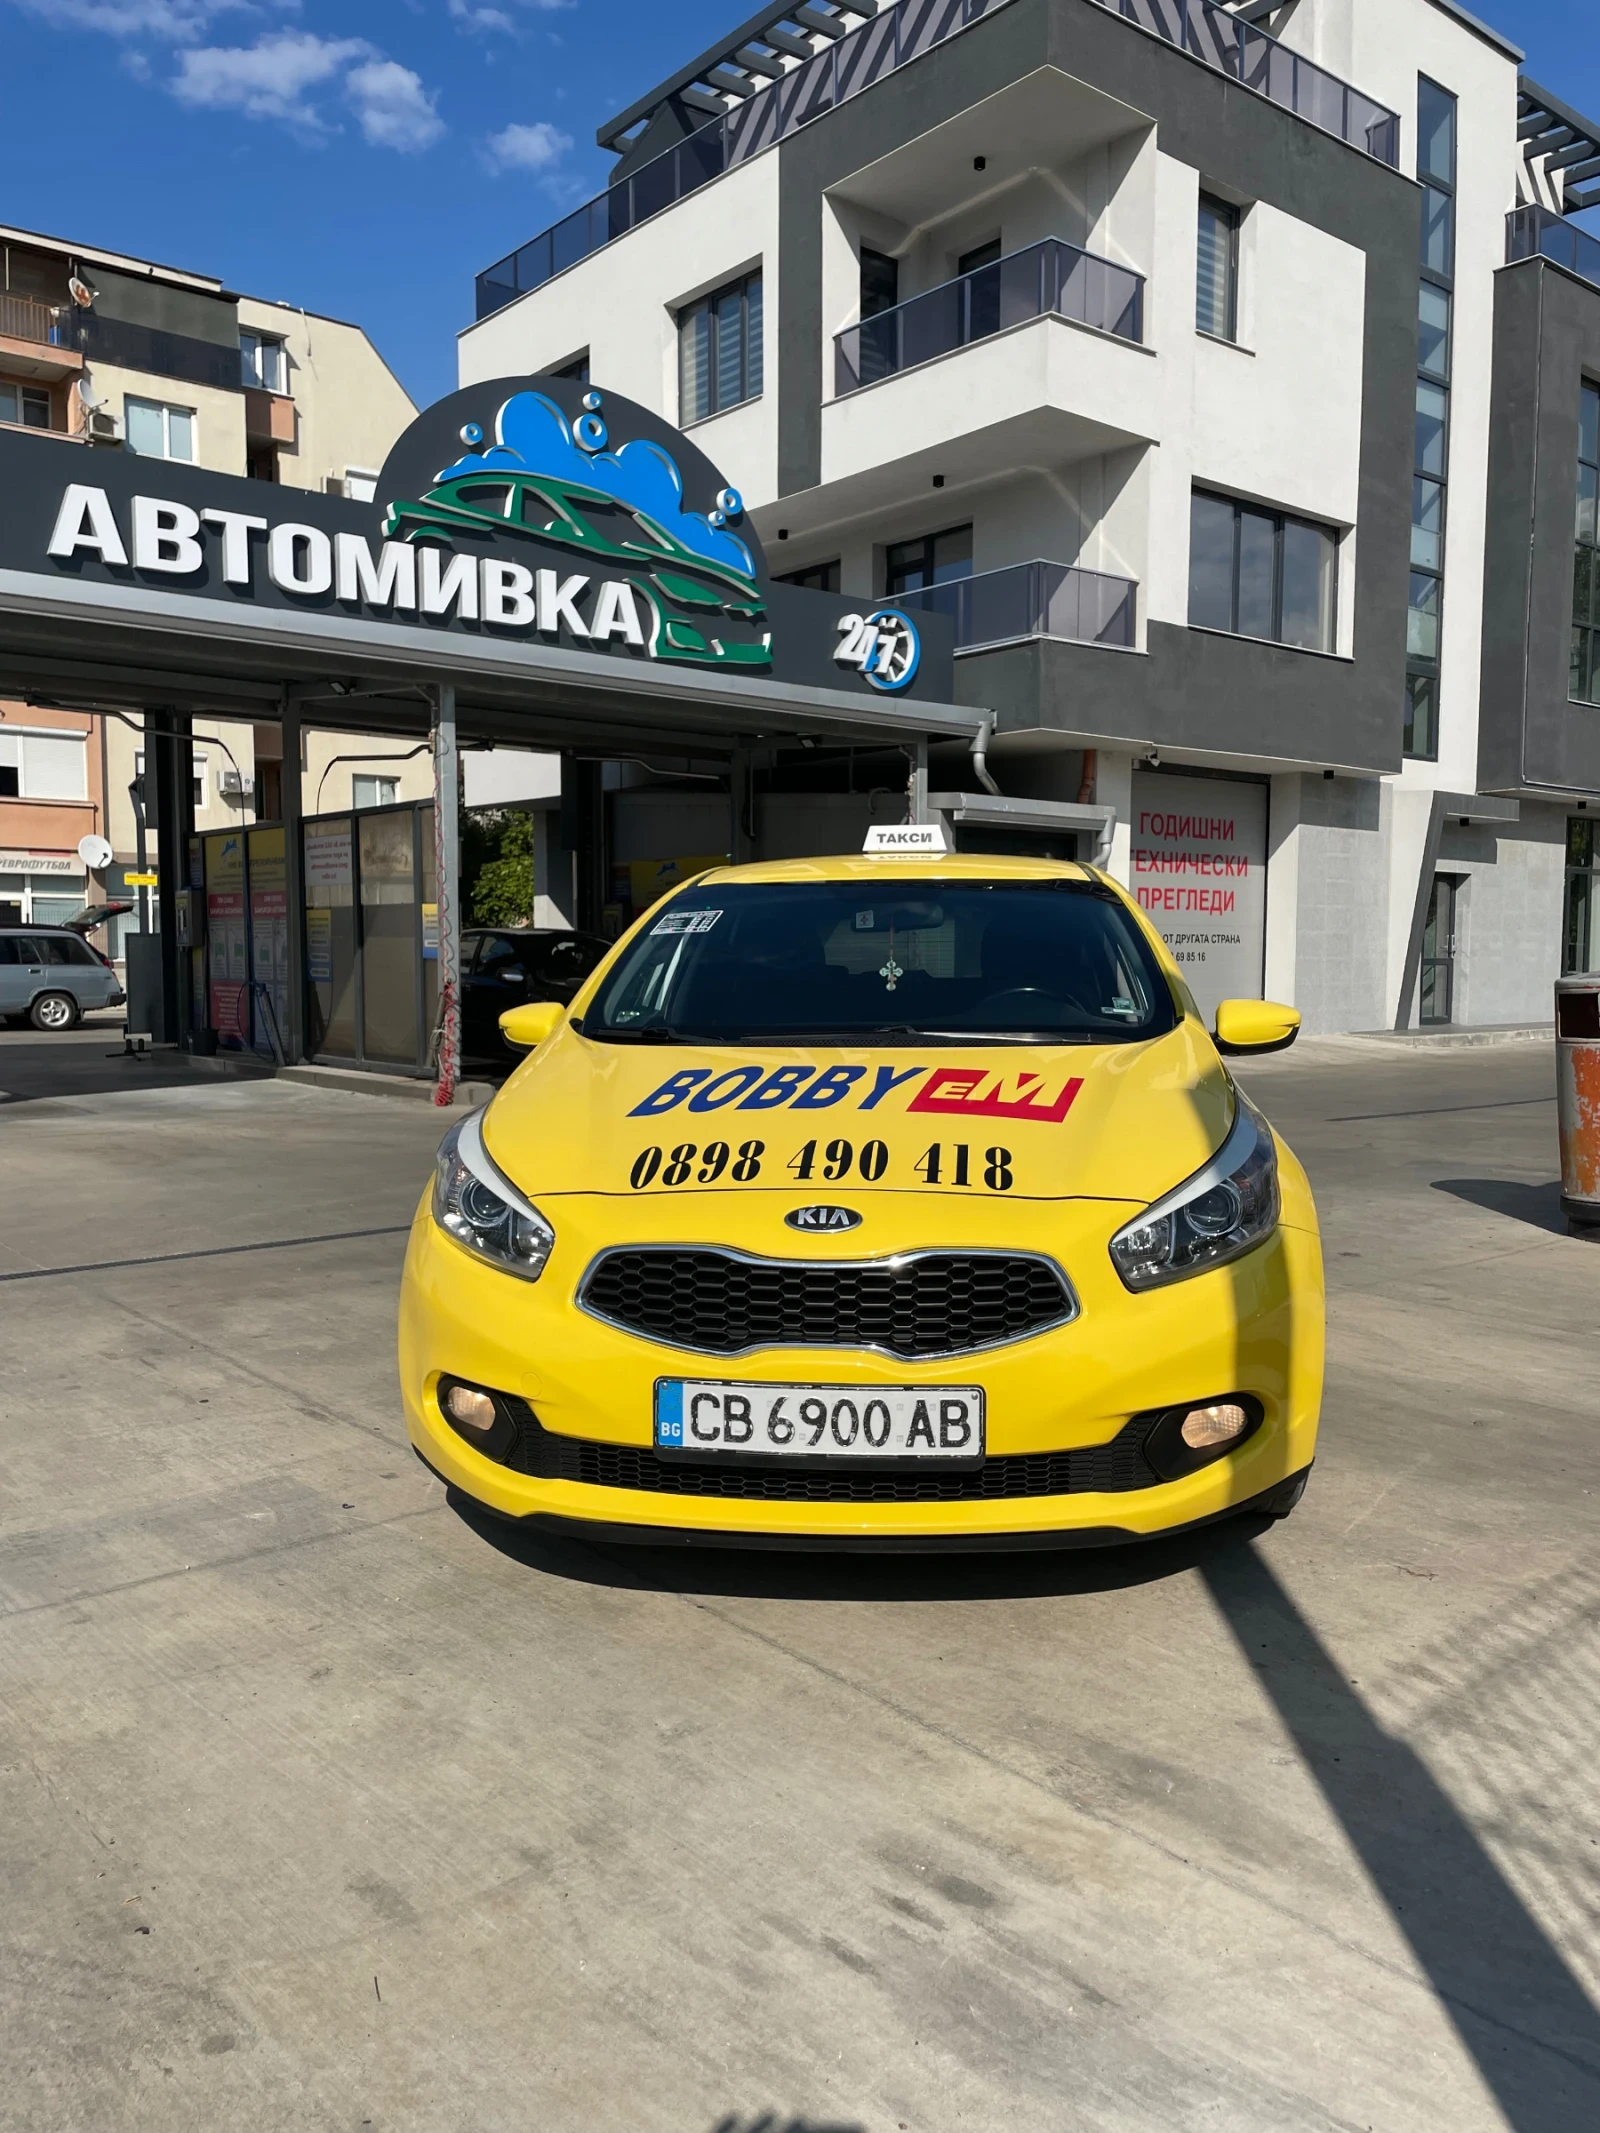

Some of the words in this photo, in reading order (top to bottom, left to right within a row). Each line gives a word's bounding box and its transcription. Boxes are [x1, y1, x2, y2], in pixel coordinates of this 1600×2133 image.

[47, 483, 645, 645] АВТОМИВКА
[876, 833, 932, 843] ТАКСИ
[1140, 812, 1234, 841] ГОДИШНИ
[2, 859, 71, 870] ЕВРОФУТБОЛ
[1137, 887, 1235, 915] ПРЕГЛЕДИ
[1162, 934, 1173, 944] ОТ
[1175, 934, 1209, 945] ДРУГАТА
[1211, 934, 1241, 944] СТРАНА
[1175, 952, 1185, 962] 69
[1186, 952, 1196, 962] 85
[1197, 952, 1206, 962] 16
[625, 1065, 930, 1118] BOBBY
[630, 1140, 765, 1189] 0898
[786, 1139, 889, 1181] 490
[913, 1142, 1013, 1190] 418
[797, 1208, 850, 1225] KIA
[661, 1423, 681, 1437] BG
[690, 1392, 755, 1443] CB
[766, 1395, 891, 1448] 6900
[905, 1398, 972, 1448] AB
